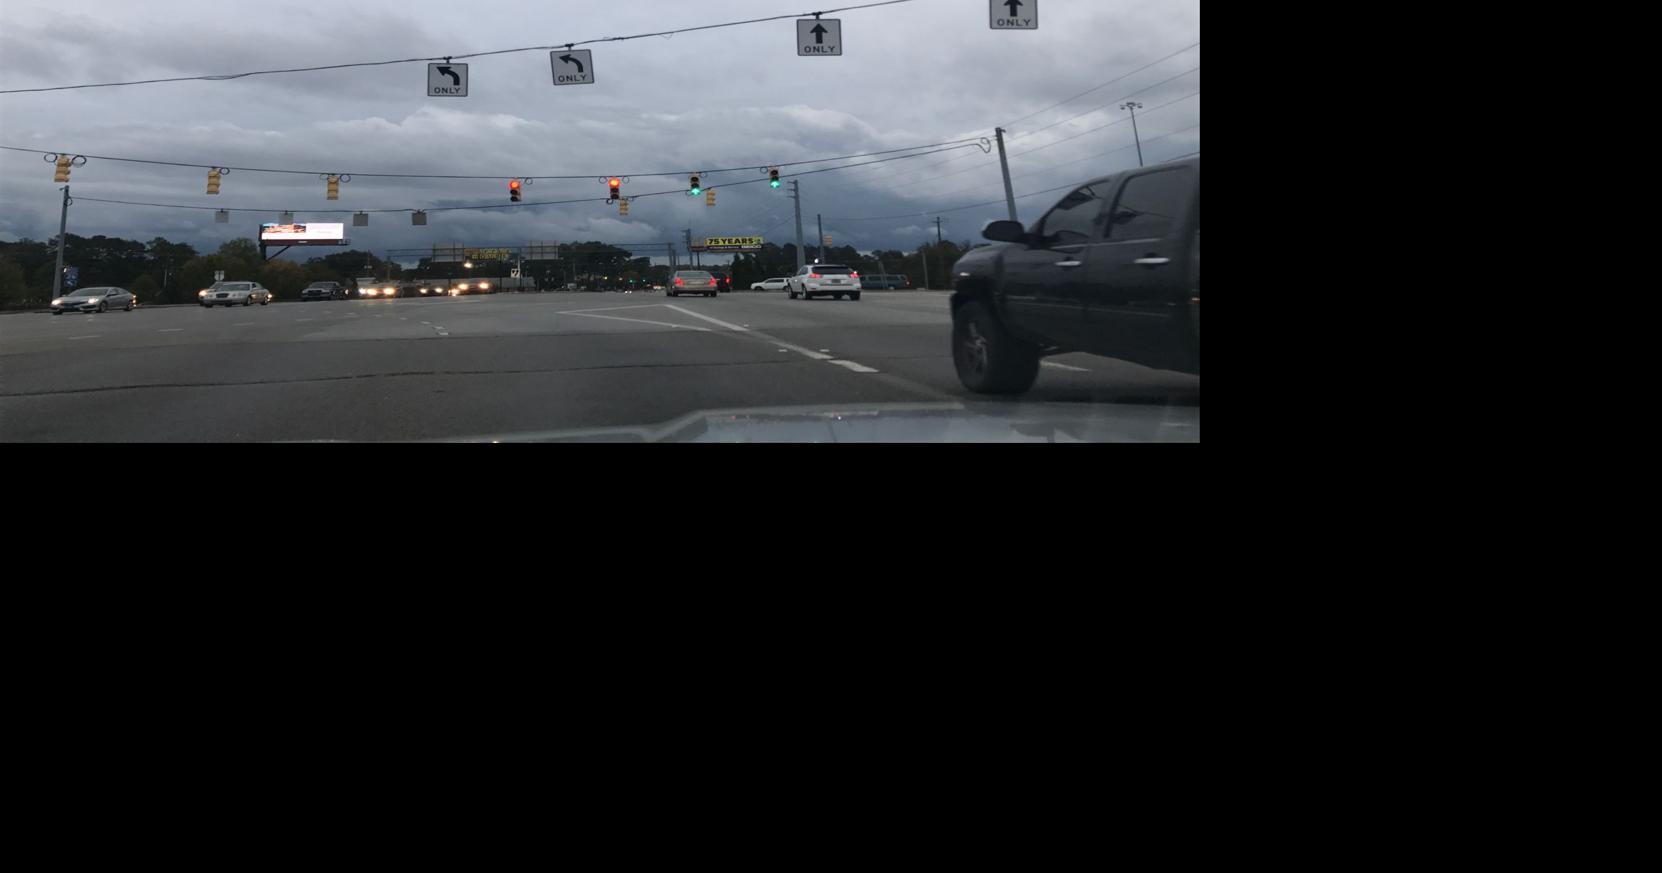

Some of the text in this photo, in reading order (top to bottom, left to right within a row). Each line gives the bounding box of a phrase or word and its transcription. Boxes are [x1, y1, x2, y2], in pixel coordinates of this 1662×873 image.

[997, 19, 1031, 27] ONLY
[804, 46, 835, 54] ONLY
[558, 73, 587, 83] ONLY
[434, 87, 461, 95] ONLY
[720, 237, 755, 245] YEARS
